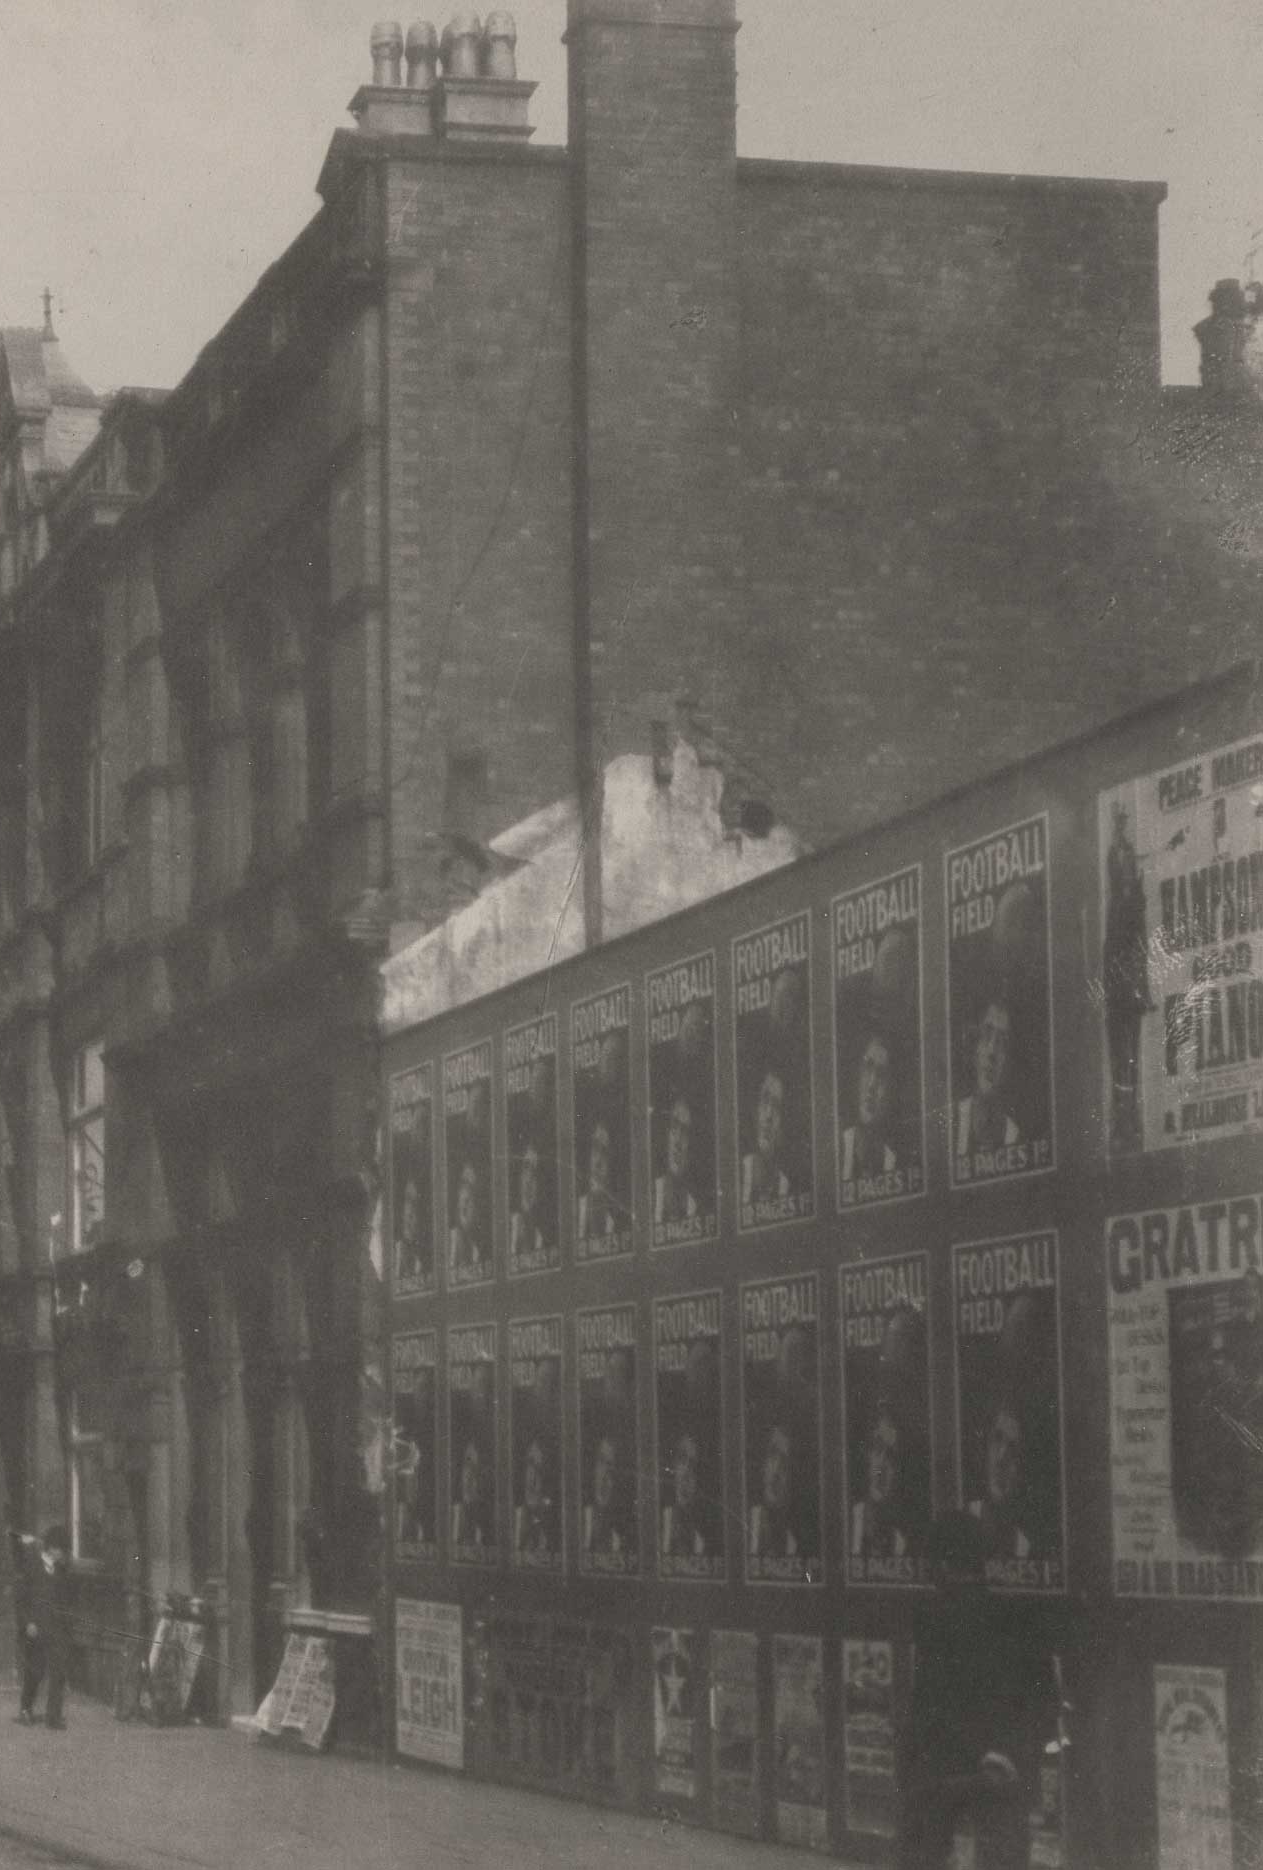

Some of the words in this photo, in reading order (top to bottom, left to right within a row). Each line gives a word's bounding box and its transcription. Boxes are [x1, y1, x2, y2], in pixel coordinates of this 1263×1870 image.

[1159, 765, 1202, 811] PEACE
[950, 825, 1045, 903] FOOTBALL
[836, 876, 918, 946] FOOTBALL
[951, 894, 996, 940] FIELD
[736, 920, 808, 983] FOOTBALL
[837, 937, 875, 980] FIELD
[650, 956, 713, 1013] FOOTBALL
[737, 977, 771, 1016] FIELD
[974, 1144, 1028, 1175] PAGES
[857, 1170, 905, 1199] PAGES
[959, 1239, 1054, 1298] FOOTBALL
[1110, 1197, 1263, 1294] GRATR
[744, 1281, 816, 1330] FOOTBALL
[844, 1261, 926, 1314] FOOTBALL
[656, 1297, 720, 1343] FOOTBALL
[845, 1315, 885, 1348] FIELD
[960, 1298, 1004, 1334] FIELD
[985, 1559, 1039, 1584] PAGES
